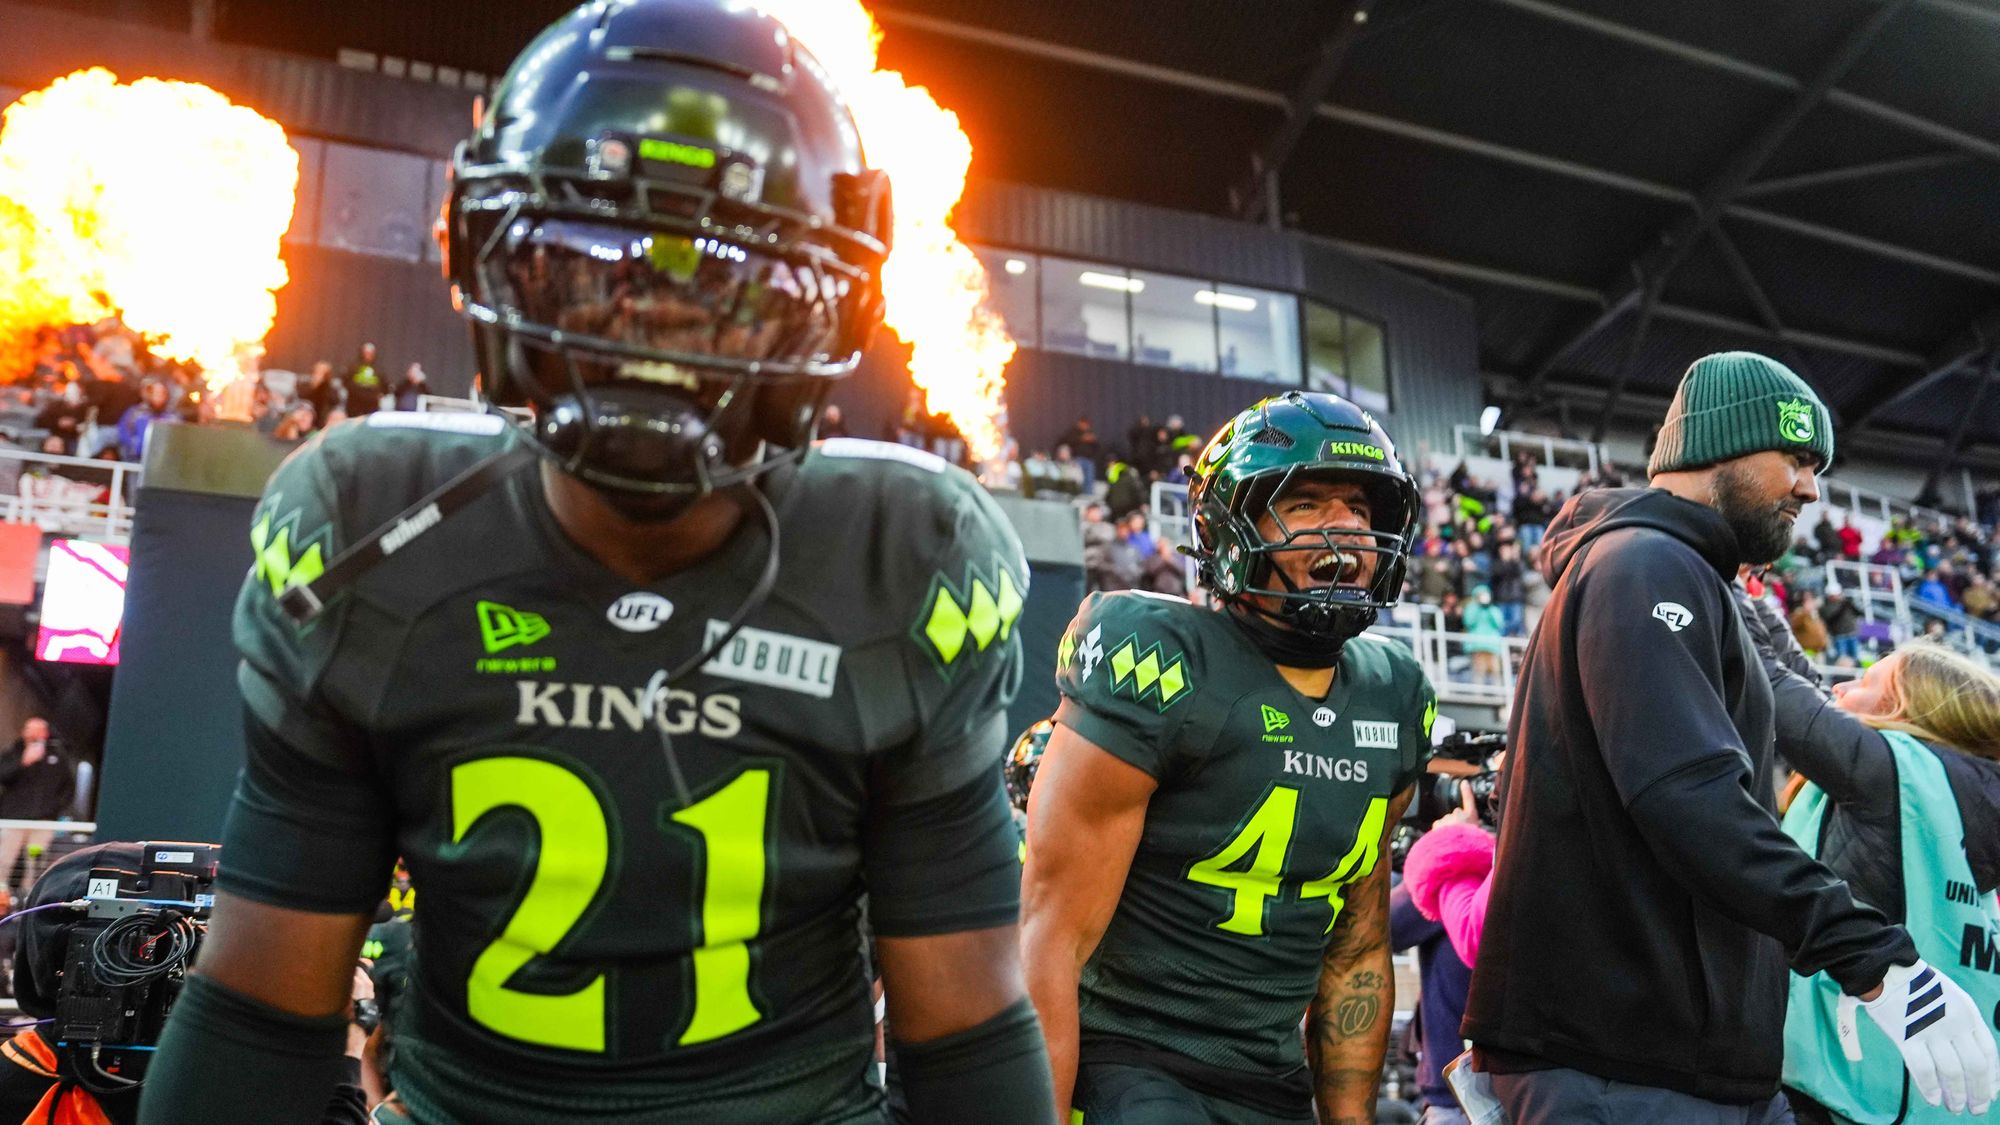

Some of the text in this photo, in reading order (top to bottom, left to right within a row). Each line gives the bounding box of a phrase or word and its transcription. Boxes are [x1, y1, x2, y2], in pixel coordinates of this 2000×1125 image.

[1330, 441, 1385, 461] KINGS
[615, 600, 666, 624] UFL
[516, 679, 741, 738] KINGS
[1315, 711, 1333, 723] UFL
[1355, 724, 1397, 744] NOBULL
[1283, 750, 1369, 783] KINGS
[1187, 786, 1388, 935] 44
[92, 881, 112, 896] A1
[452, 756, 769, 1052] 21
